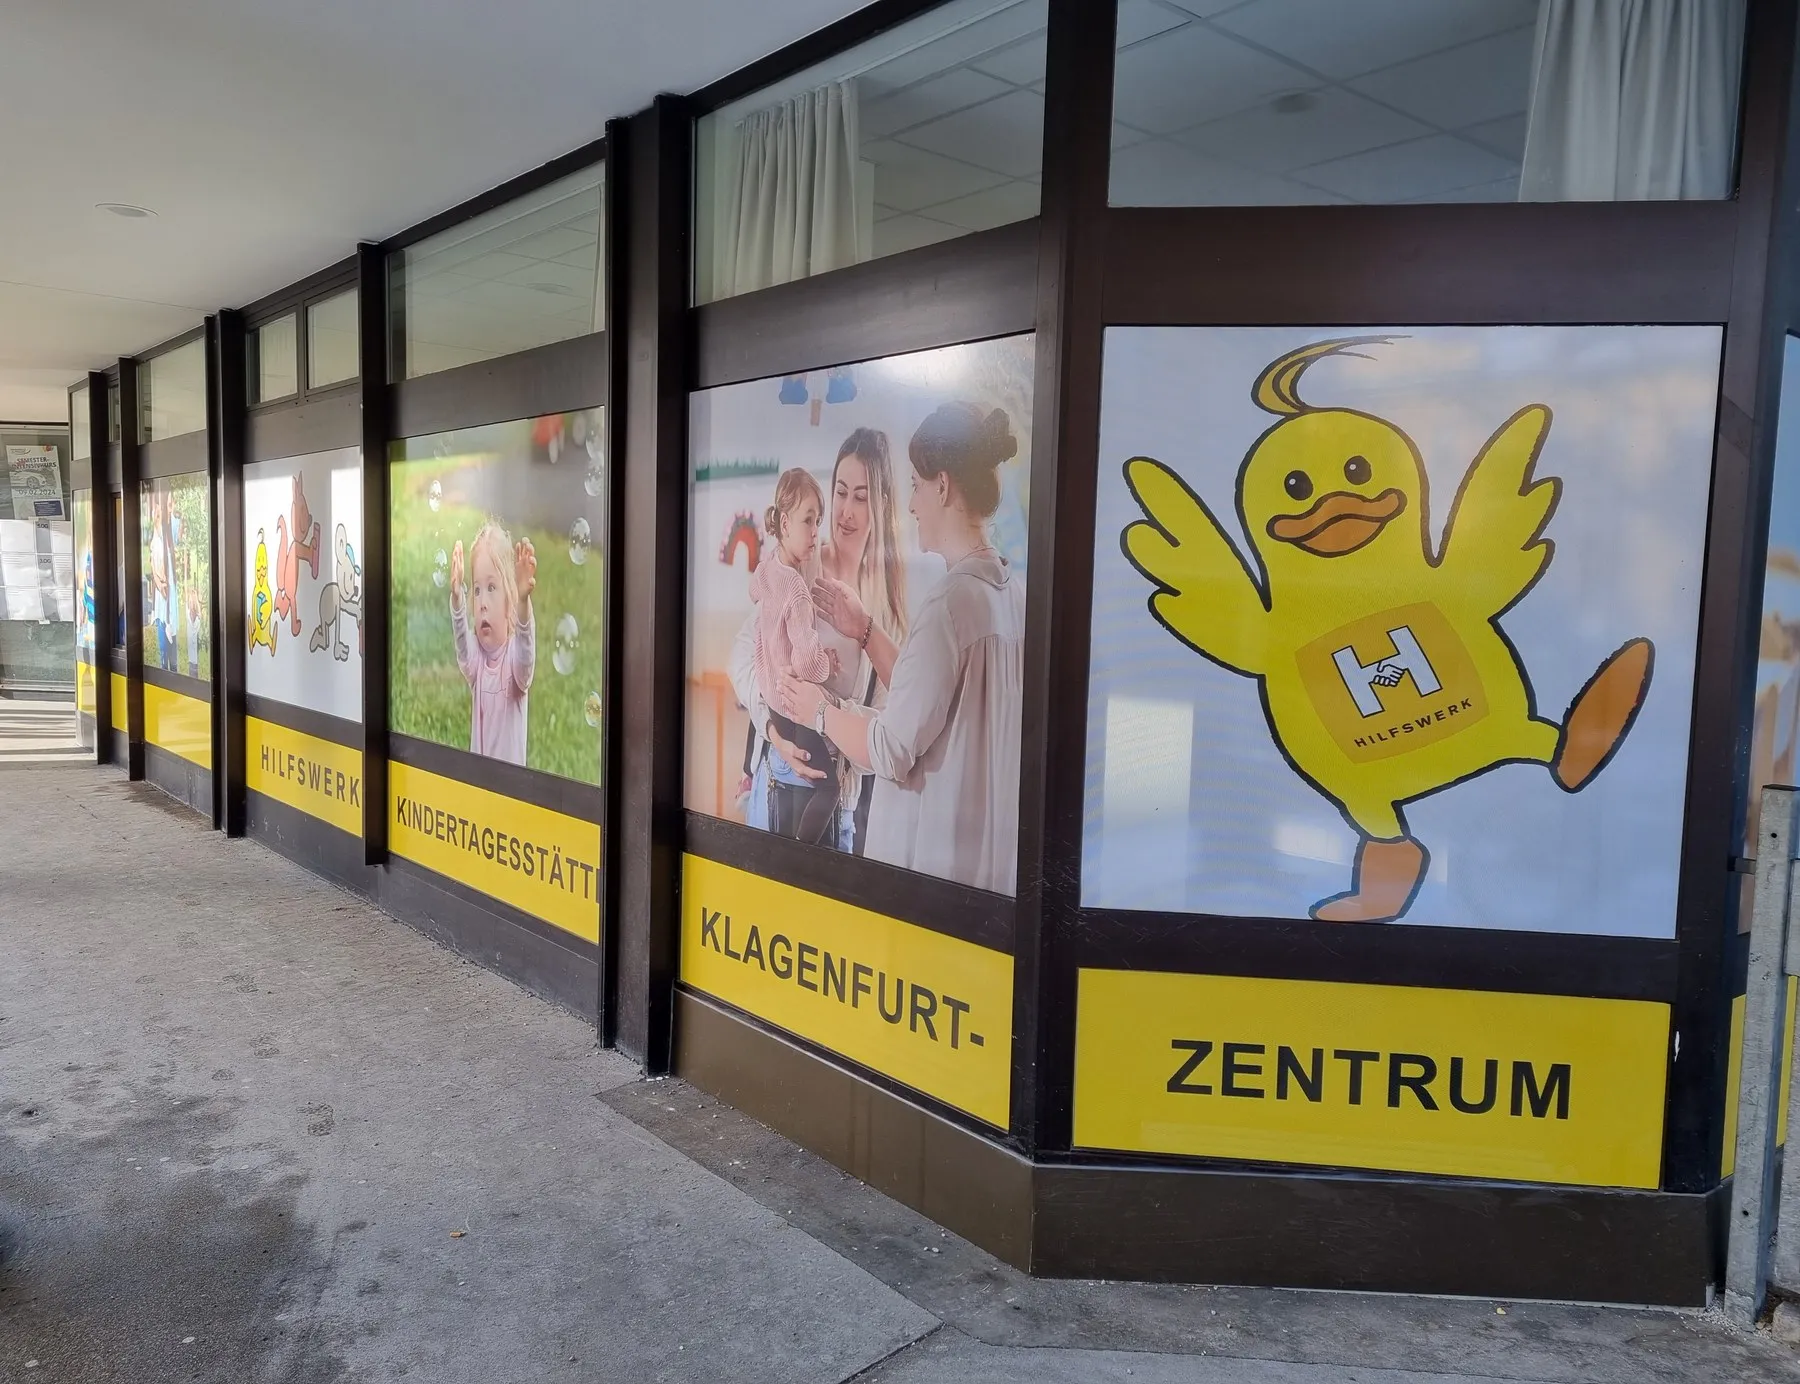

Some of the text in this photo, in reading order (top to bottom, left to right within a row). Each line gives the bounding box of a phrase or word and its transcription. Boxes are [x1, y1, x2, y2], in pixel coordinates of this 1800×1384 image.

[1331, 625, 1443, 718] H
[1354, 698, 1473, 748] HILFSWERK
[261, 744, 361, 808] HILFSWERK
[701, 907, 985, 1050] KLAGENFURT-
[1167, 1039, 1571, 1120] ZENTRUM
